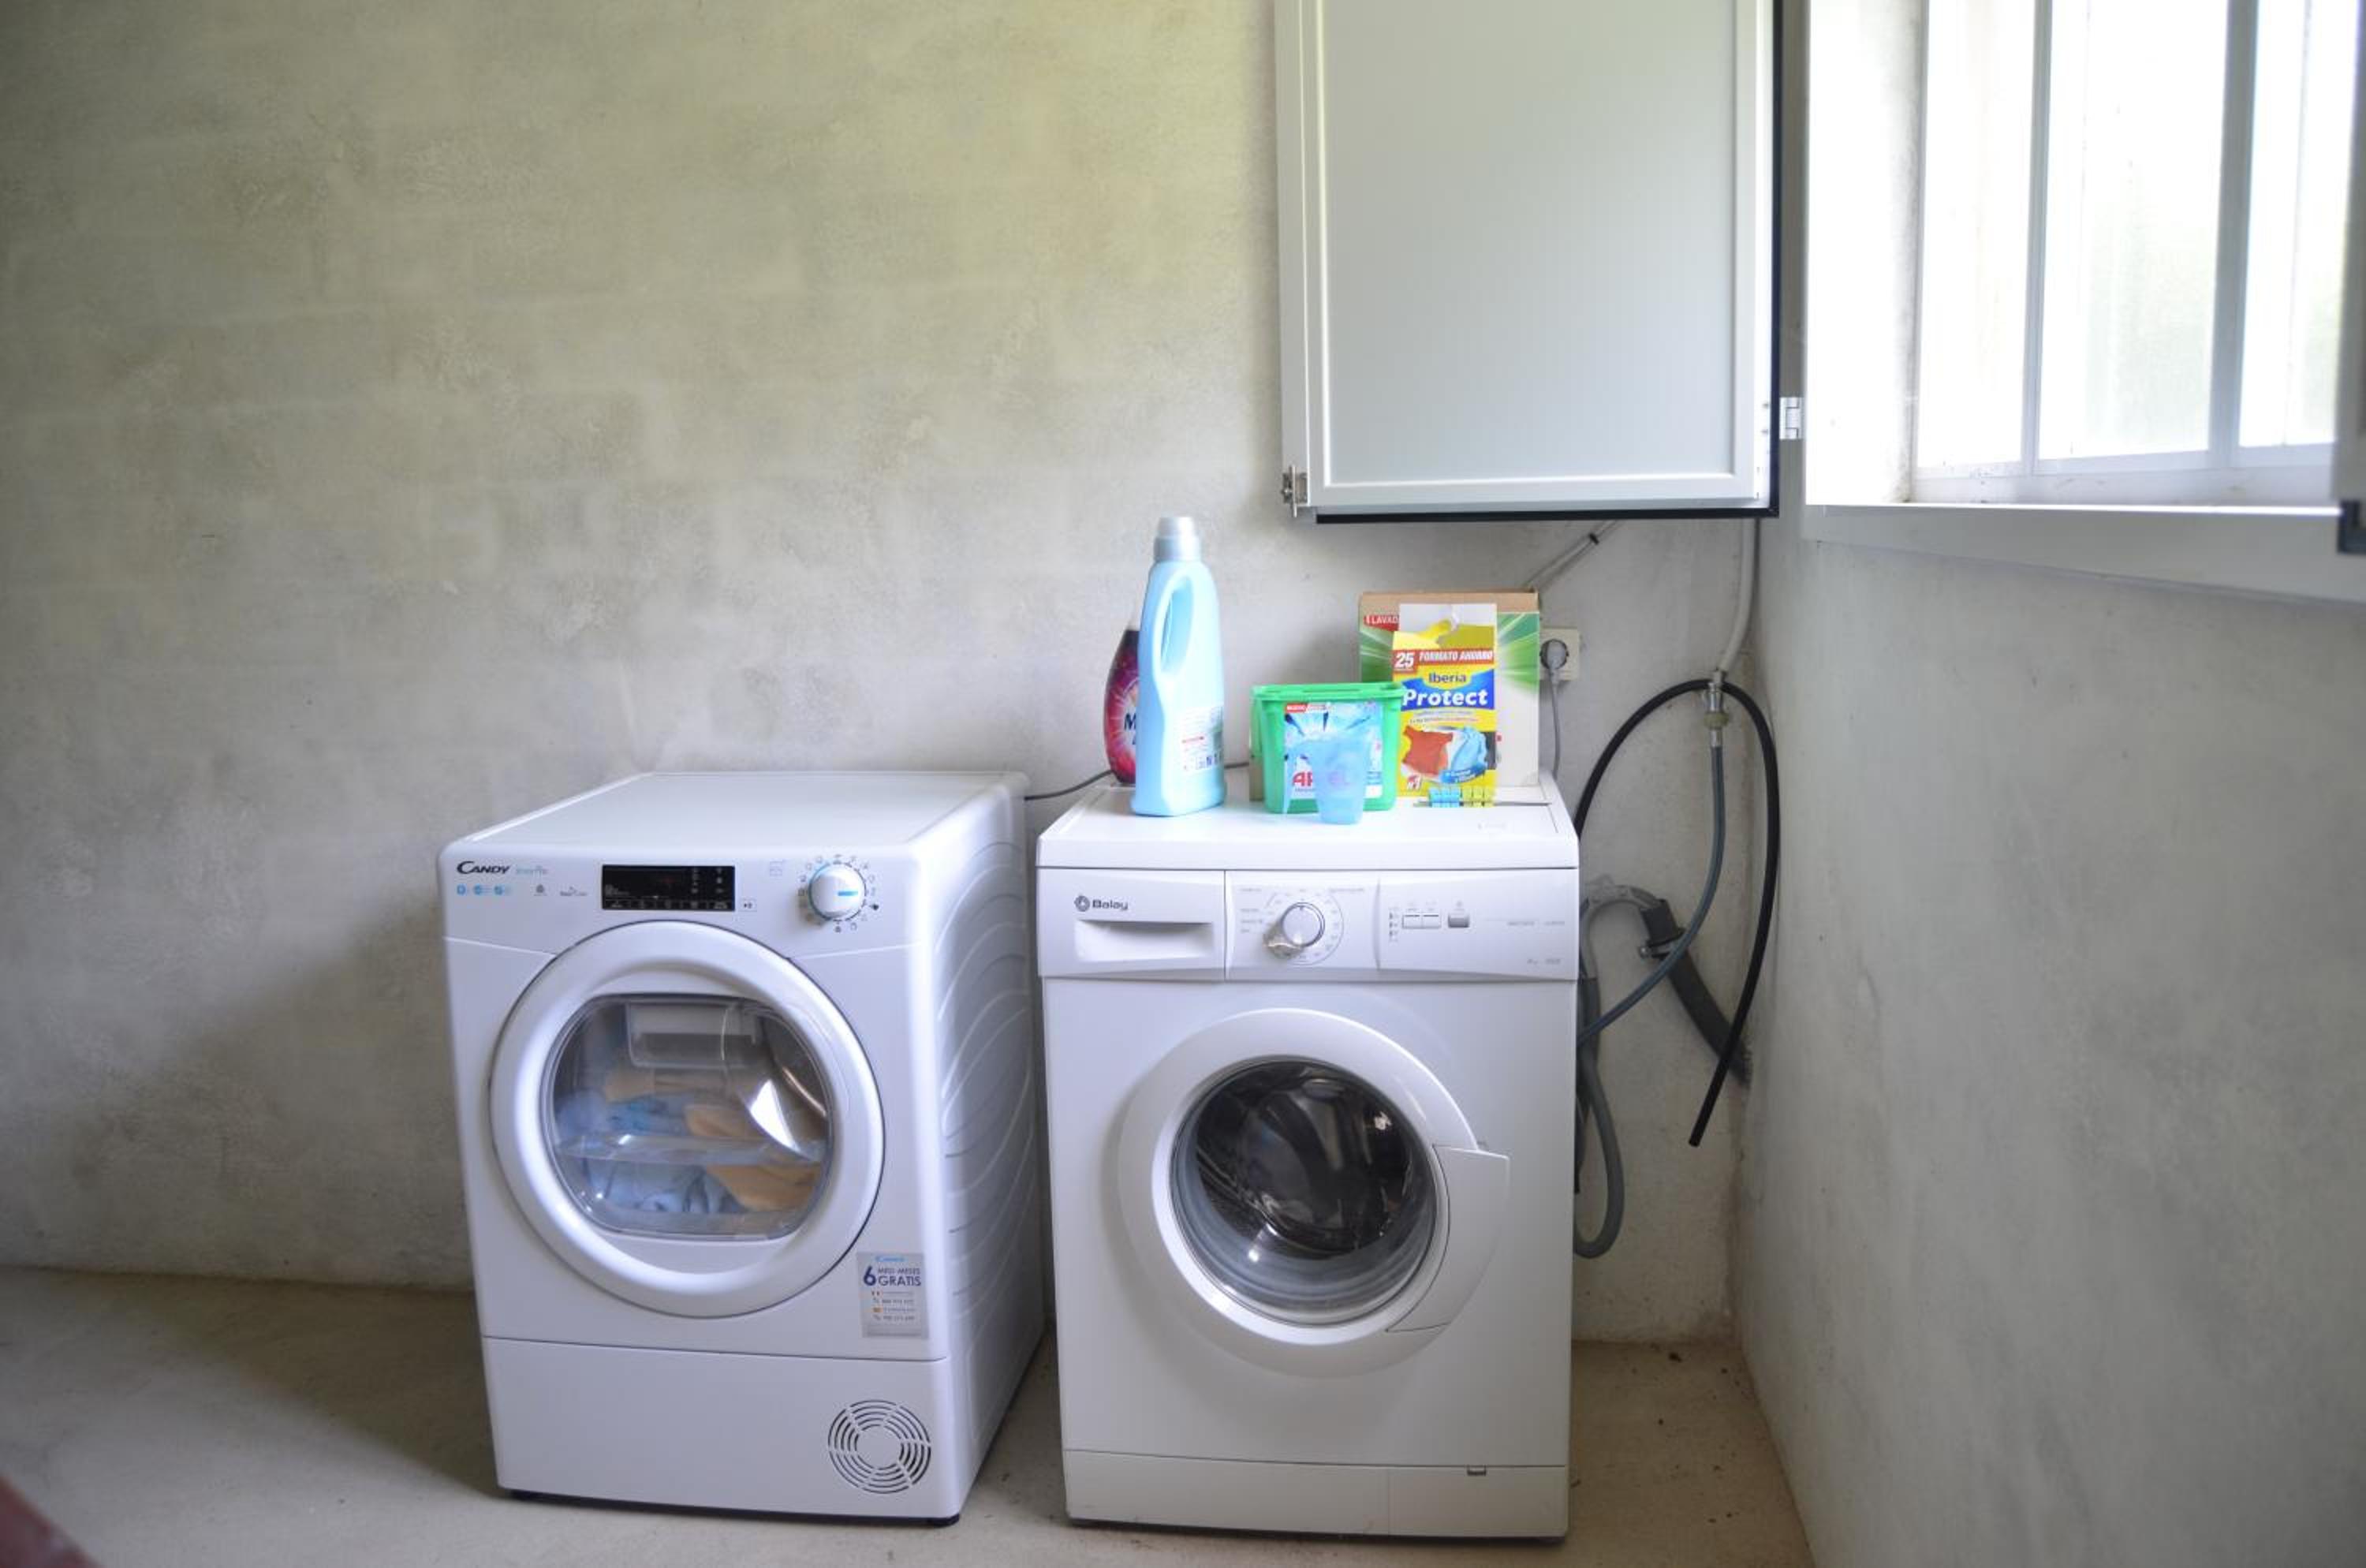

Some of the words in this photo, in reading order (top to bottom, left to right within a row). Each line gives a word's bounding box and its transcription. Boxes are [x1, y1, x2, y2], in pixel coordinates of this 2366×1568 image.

[1394, 651, 1414, 669] 25
[1419, 650, 1458, 662] FORMATO
[1429, 672, 1466, 682] Iberia
[1402, 689, 1488, 707] Protect
[457, 861, 511, 874] CANDY
[1092, 899, 1129, 911] Balay
[863, 1265, 877, 1286] 6
[878, 1275, 922, 1286] GRATIS
